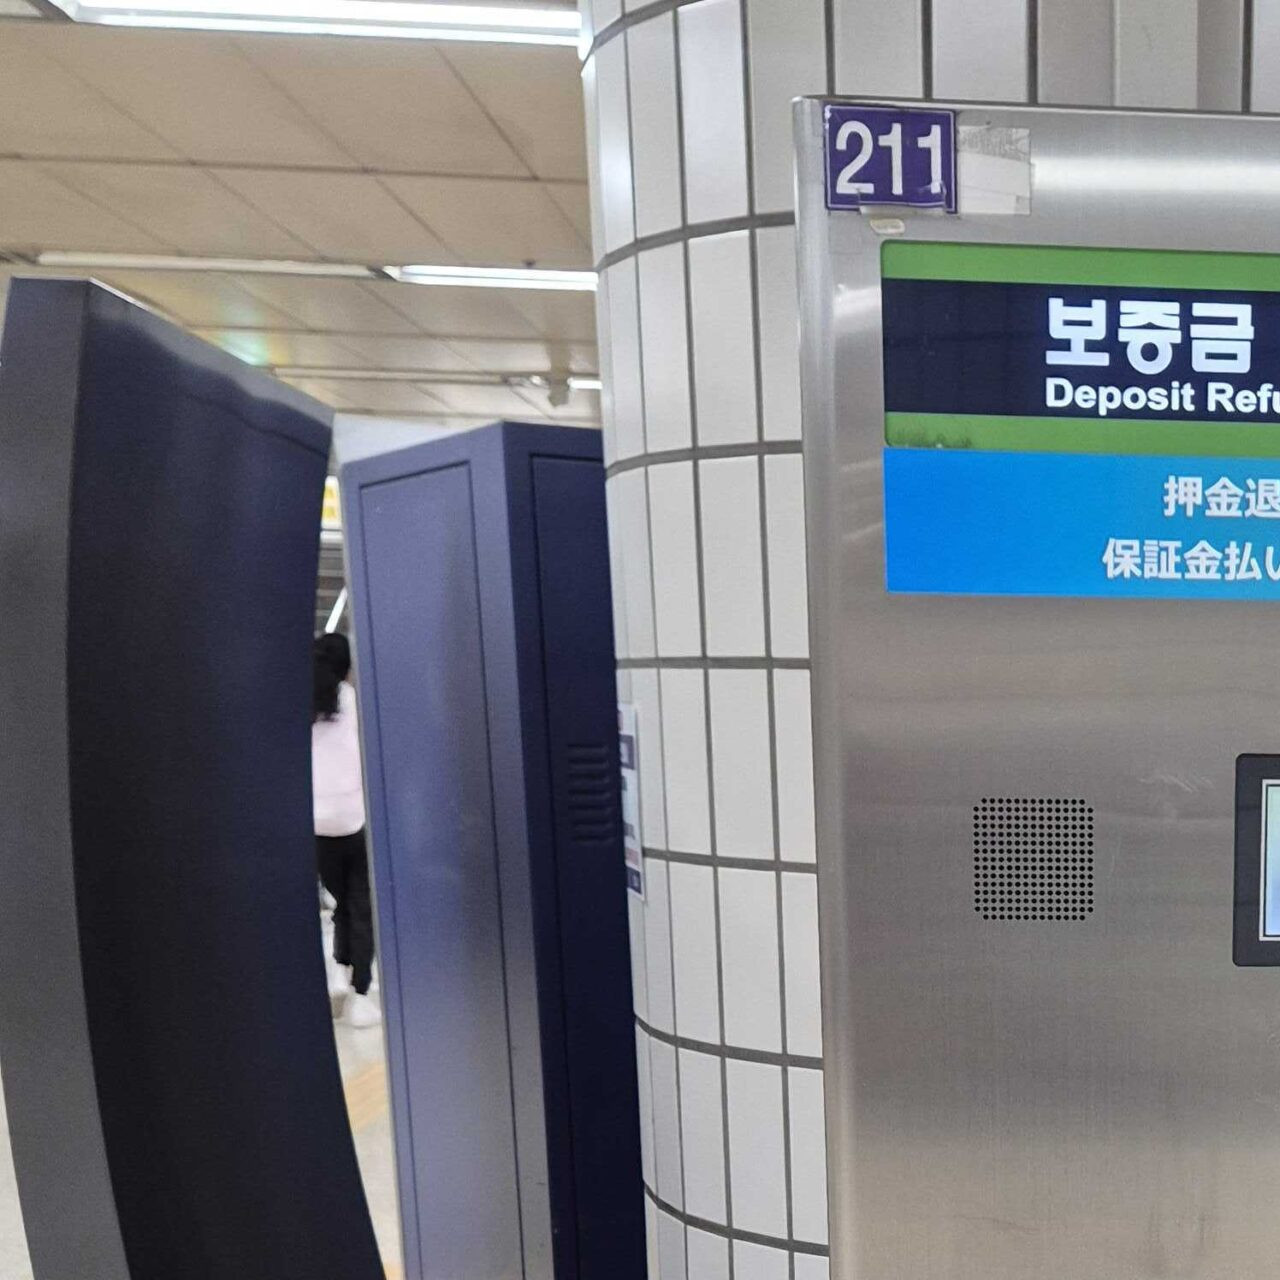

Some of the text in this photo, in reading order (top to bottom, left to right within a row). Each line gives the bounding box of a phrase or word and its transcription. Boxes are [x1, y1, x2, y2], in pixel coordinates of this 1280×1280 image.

[835, 120, 943, 196] 211
[1045, 297, 1256, 376] 보증금
[1046, 377, 1196, 416] Deposit
